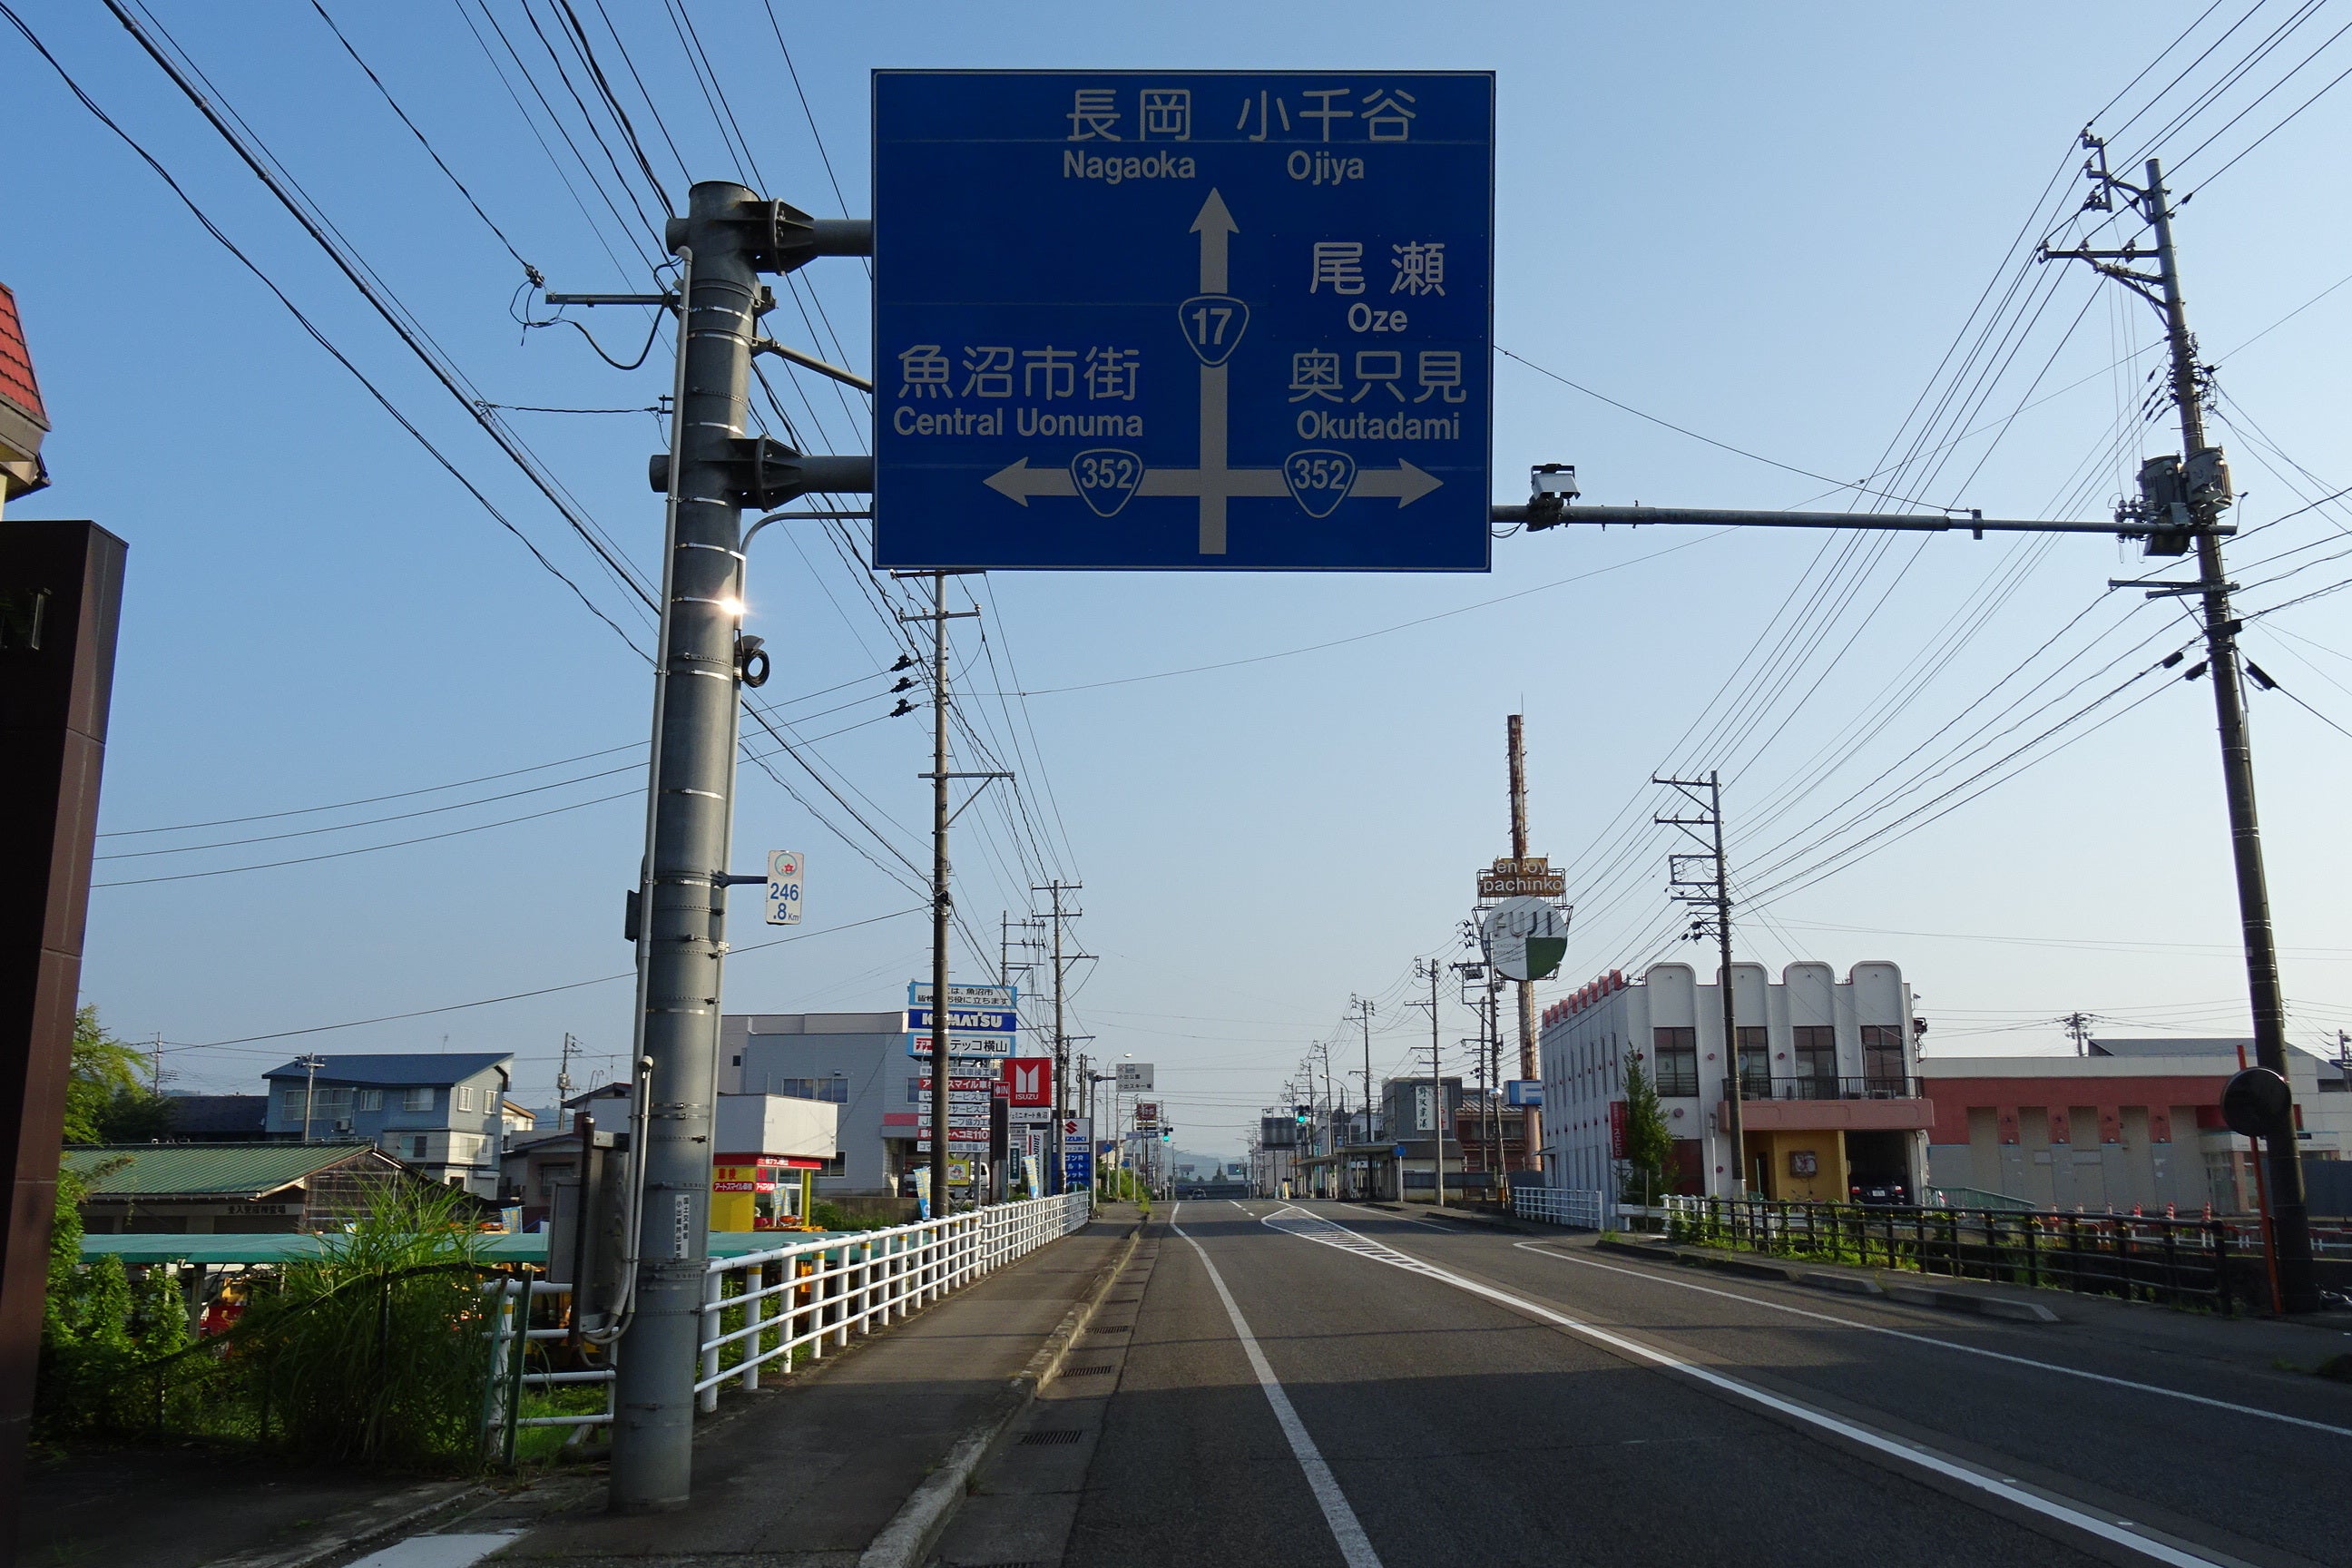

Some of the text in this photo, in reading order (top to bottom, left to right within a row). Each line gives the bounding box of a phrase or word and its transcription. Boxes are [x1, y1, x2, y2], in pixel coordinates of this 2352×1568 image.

[1068, 90, 1416, 142] 長岡 小千谷
[1063, 151, 1365, 186] Nagaoka Ojiya
[1310, 241, 1446, 297] 尾瀬
[1191, 309, 1232, 345] 17
[1348, 303, 1408, 333] Oze
[898, 345, 1141, 401] 魚沼市街
[1289, 348, 1466, 404] 奥只見
[894, 407, 1143, 437] Central Uonuma
[1297, 411, 1460, 441] Okutadami
[1082, 459, 1132, 490] 352
[1295, 459, 1345, 491] 352
[770, 883, 799, 901] 246
[1483, 877, 1563, 893] pachinko
[1494, 911, 1553, 937] FUJI
[922, 1013, 1003, 1028] KMATSU
[923, 1079, 991, 1089] アスマイル車
